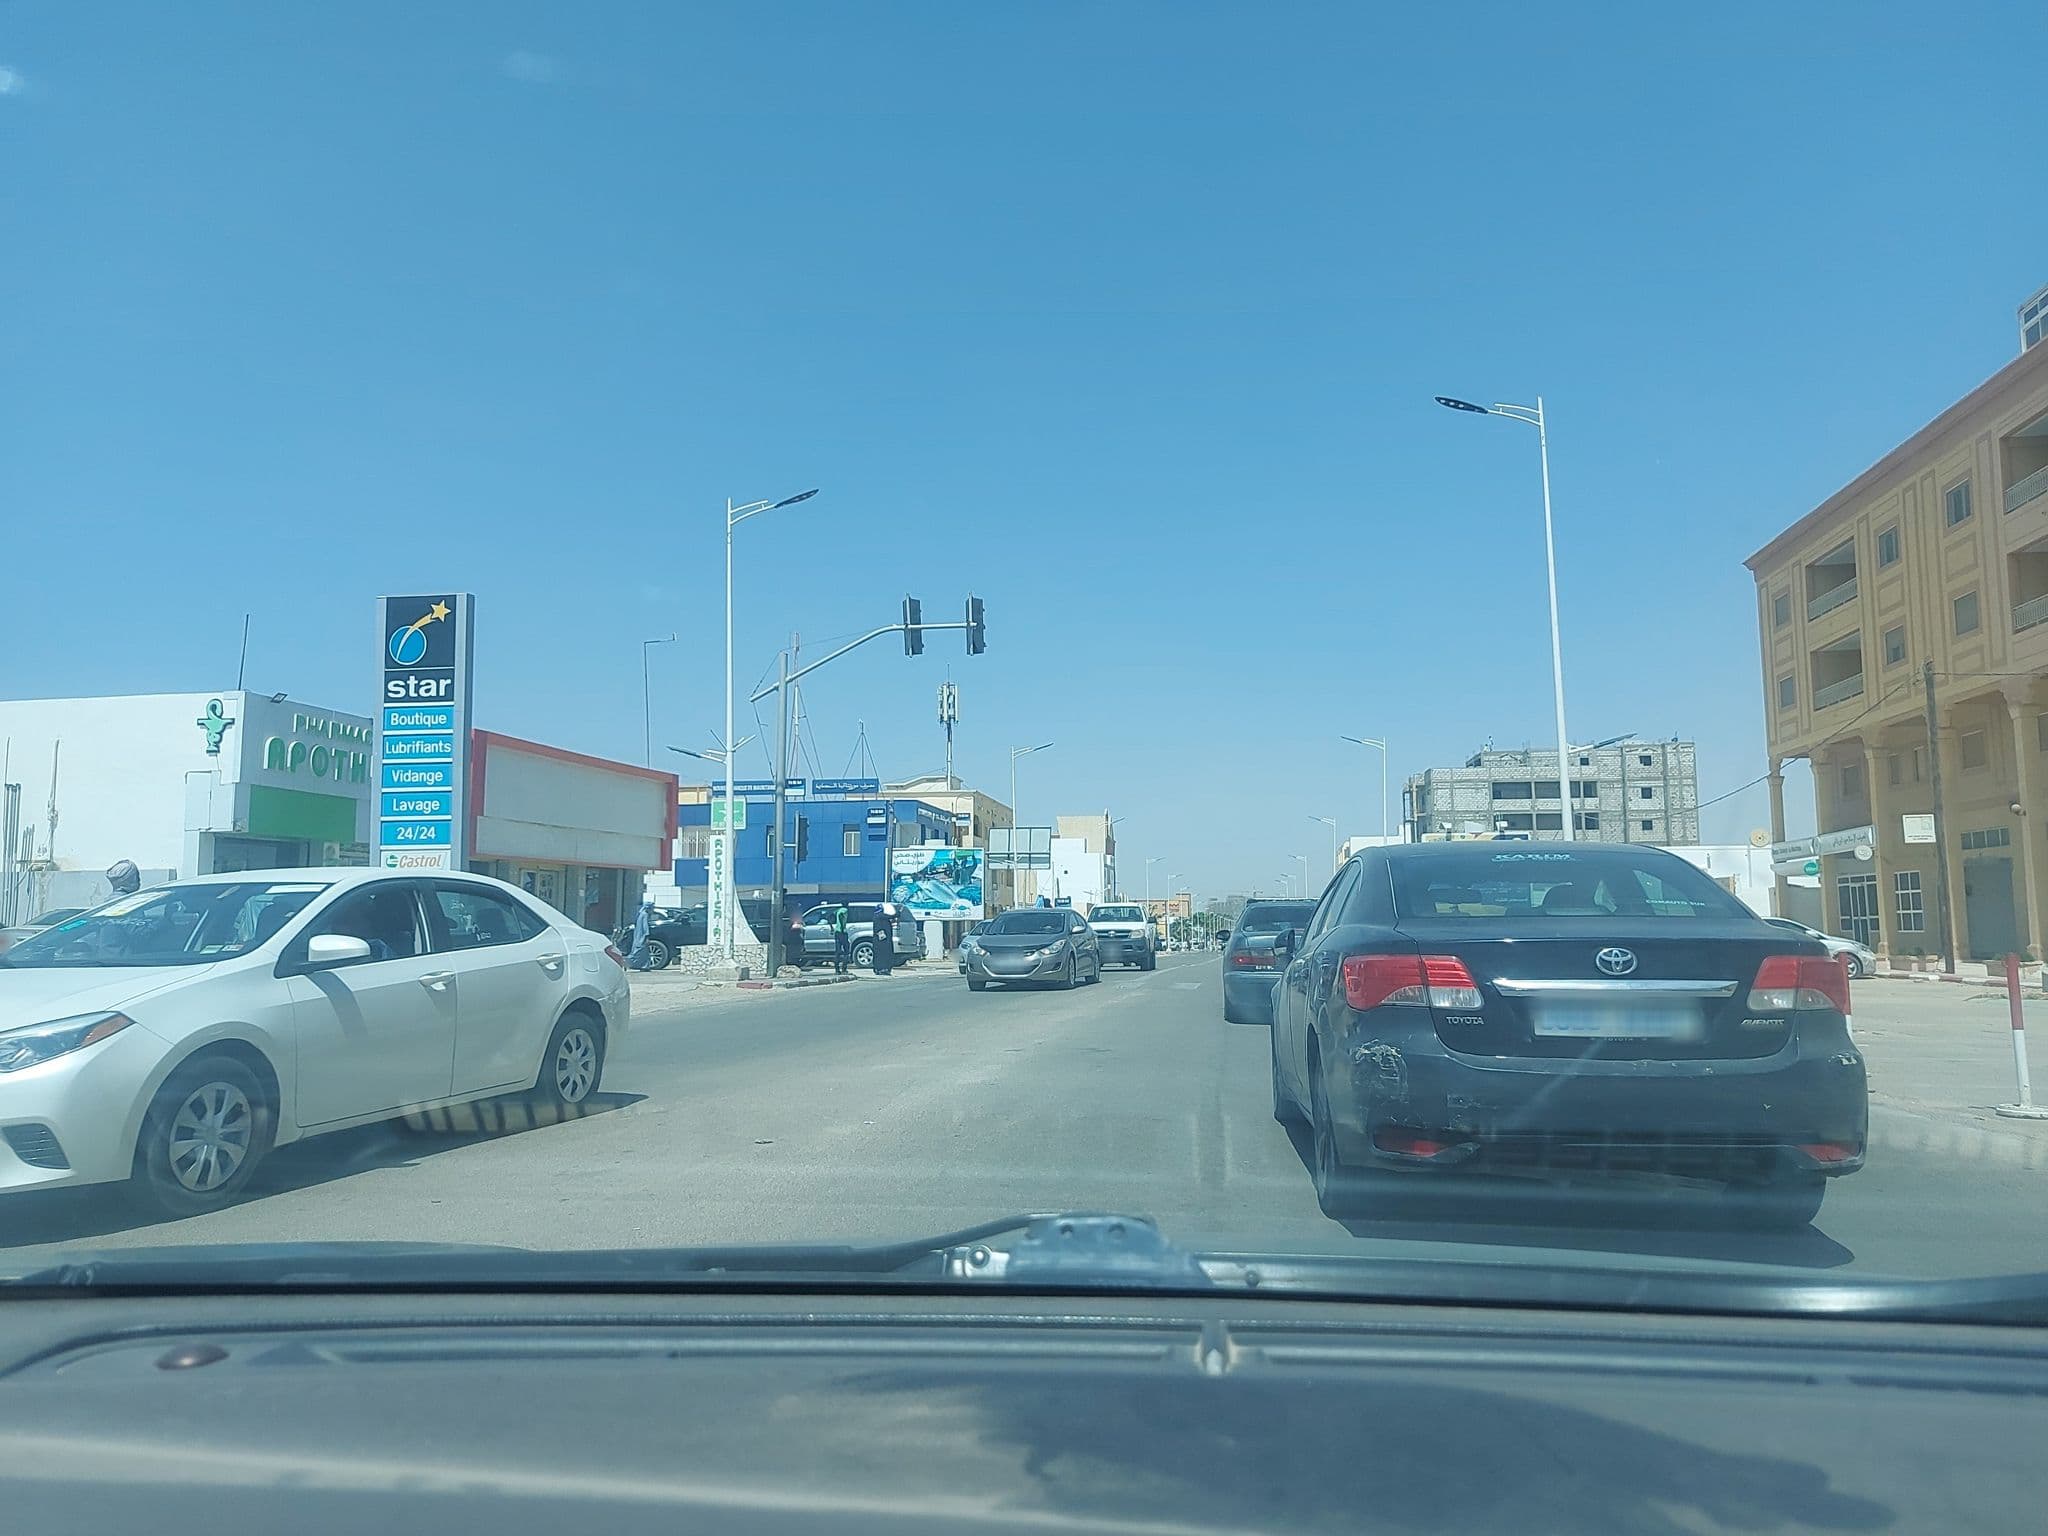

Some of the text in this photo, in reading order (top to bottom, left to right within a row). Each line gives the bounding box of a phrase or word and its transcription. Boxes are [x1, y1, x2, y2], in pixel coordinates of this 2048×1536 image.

[387, 675, 452, 699] star
[390, 713, 447, 728] Boutique
[385, 741, 452, 754] Lubrifiants
[391, 768, 444, 785] Vidange
[392, 798, 441, 813] Lavage
[396, 826, 436, 841] 24/24
[399, 855, 441, 869] Castrol
[1445, 1016, 1485, 1025] TOYOTA
